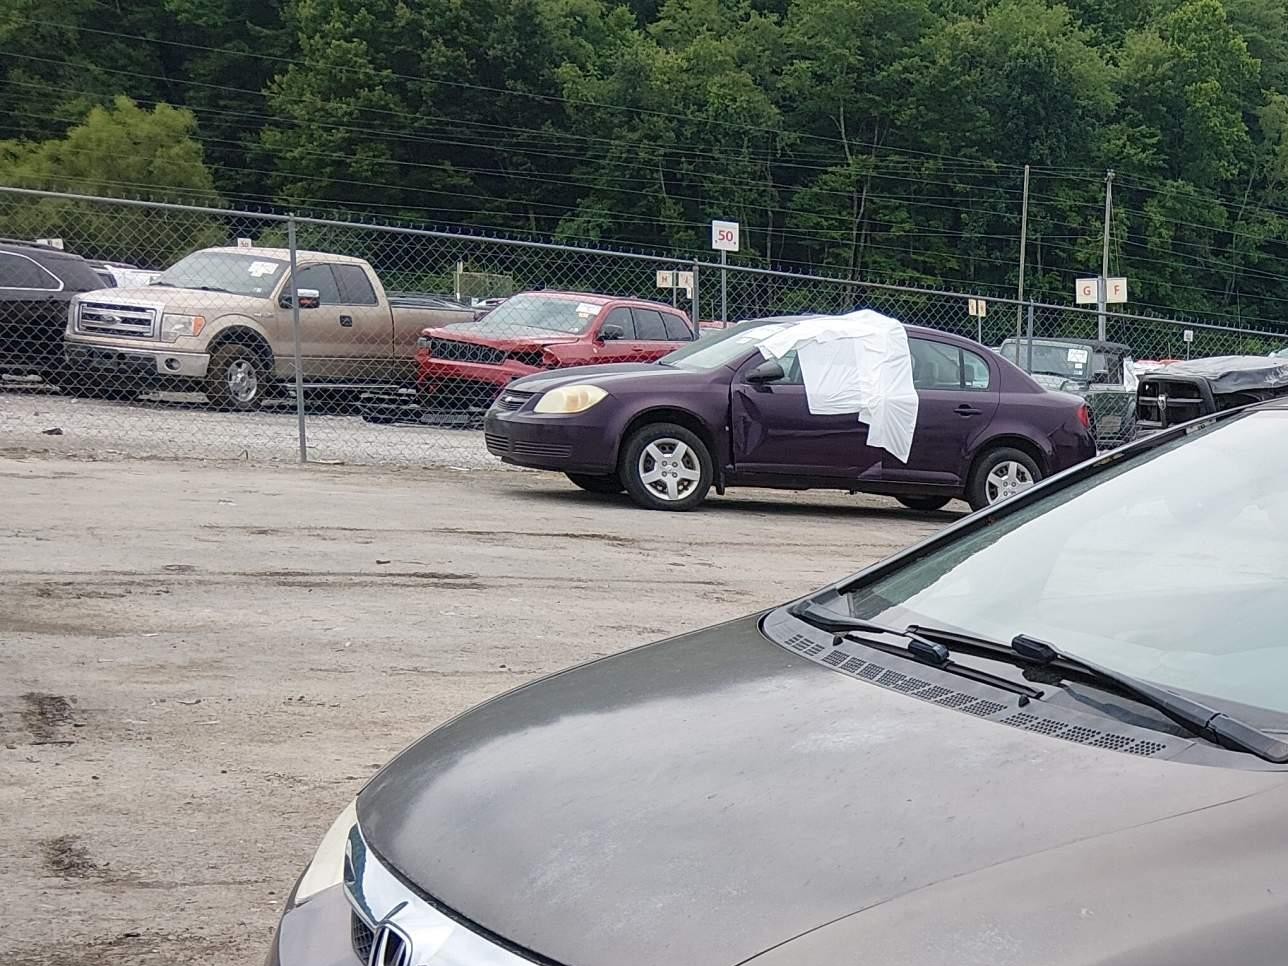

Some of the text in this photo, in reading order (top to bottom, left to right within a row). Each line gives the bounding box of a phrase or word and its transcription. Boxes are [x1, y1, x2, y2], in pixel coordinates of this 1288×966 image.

[718, 230, 733, 242] 50
[1083, 286, 1091, 295] G
[1114, 285, 1120, 295] F
